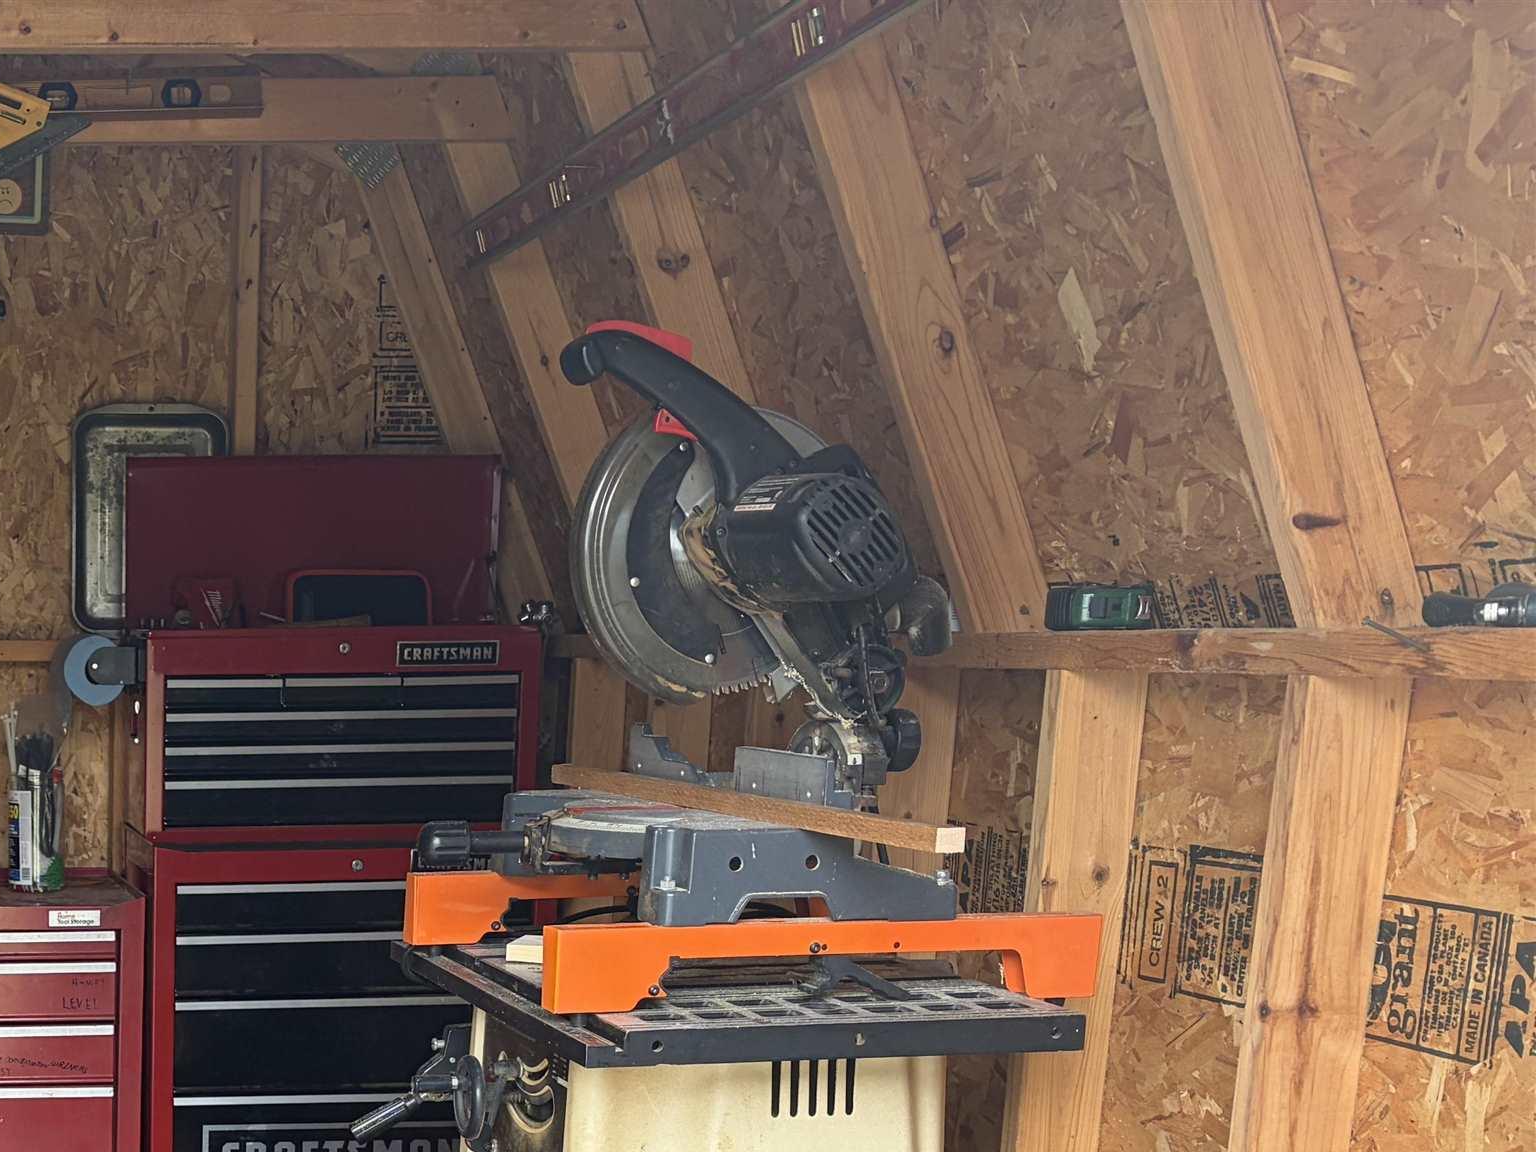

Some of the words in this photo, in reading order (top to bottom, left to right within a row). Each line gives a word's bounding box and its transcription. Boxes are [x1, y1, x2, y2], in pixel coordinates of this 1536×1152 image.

[403, 647, 493, 661] CRAFTSMAN
[1157, 875, 1169, 889] 2
[1198, 888, 1209, 929] PANELS
[1149, 901, 1166, 967] CREW
[1432, 913, 1444, 964] PRODUCTS
[1439, 927, 1449, 958] PLANT
[1474, 920, 1494, 983] CANADA
[1236, 956, 1247, 997] CENTER
[1387, 907, 1420, 1040] grant
[1471, 988, 1484, 1005] IN
[1465, 1010, 1481, 1053] MADE
